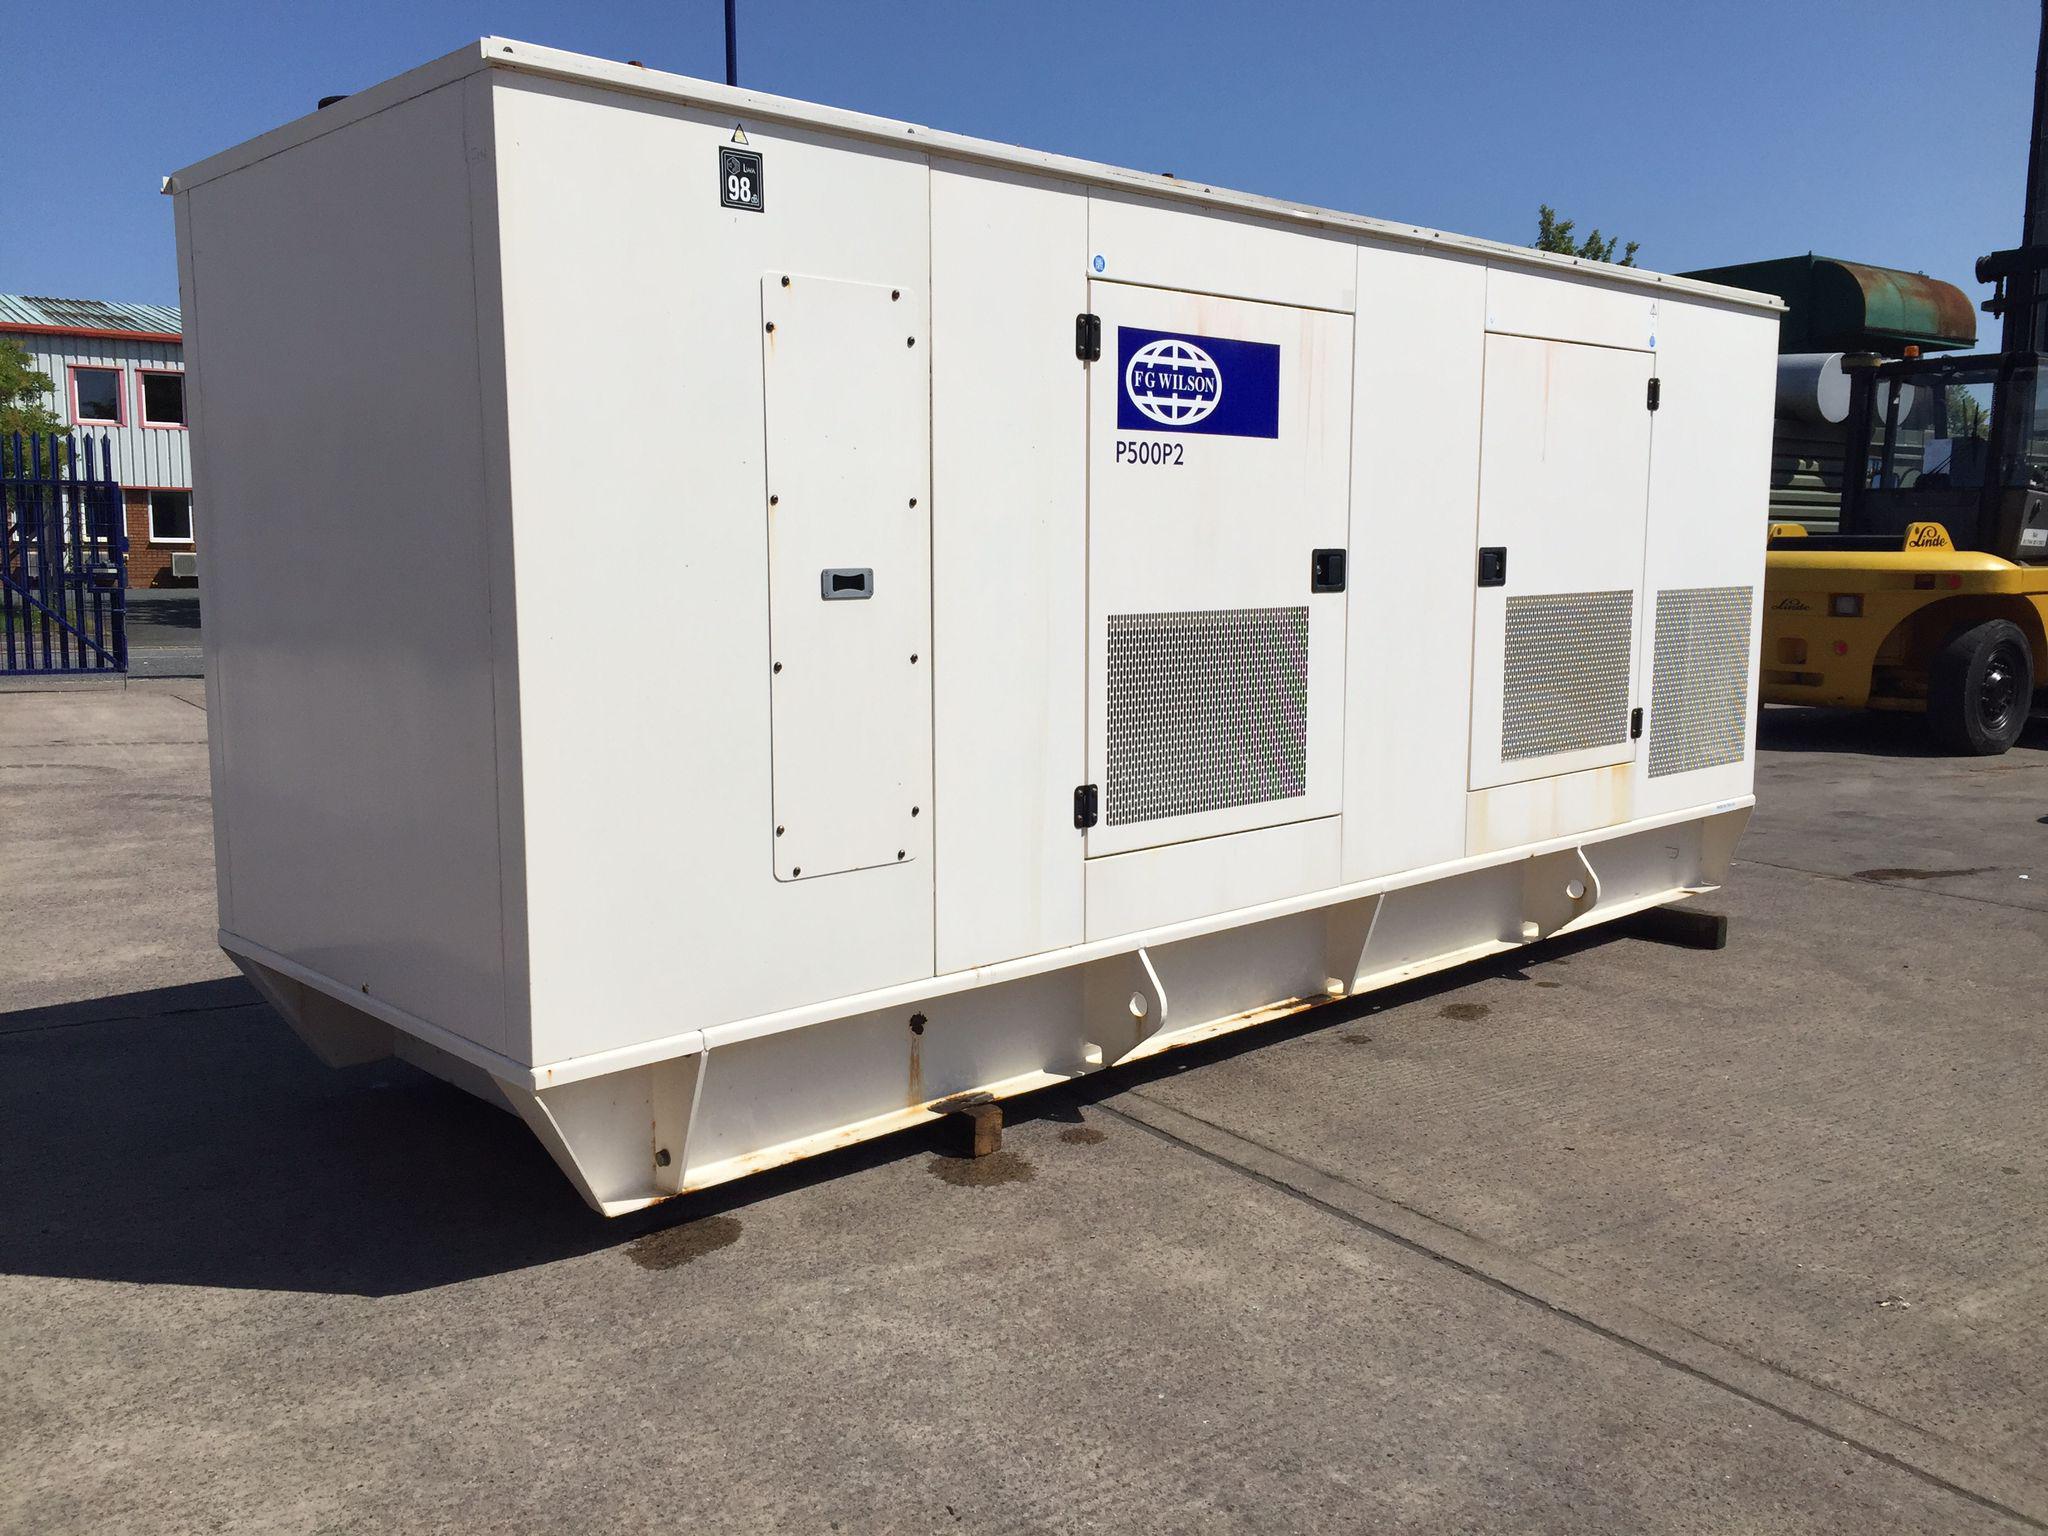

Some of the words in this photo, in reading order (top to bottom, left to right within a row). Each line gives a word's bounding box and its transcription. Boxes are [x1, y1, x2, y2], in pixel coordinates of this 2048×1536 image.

[728, 174, 751, 202] 98
[1134, 370, 1156, 388] FG
[1158, 372, 1214, 393] WILSON
[1116, 440, 1184, 465] P500P2
[1909, 525, 1947, 547] Linde
